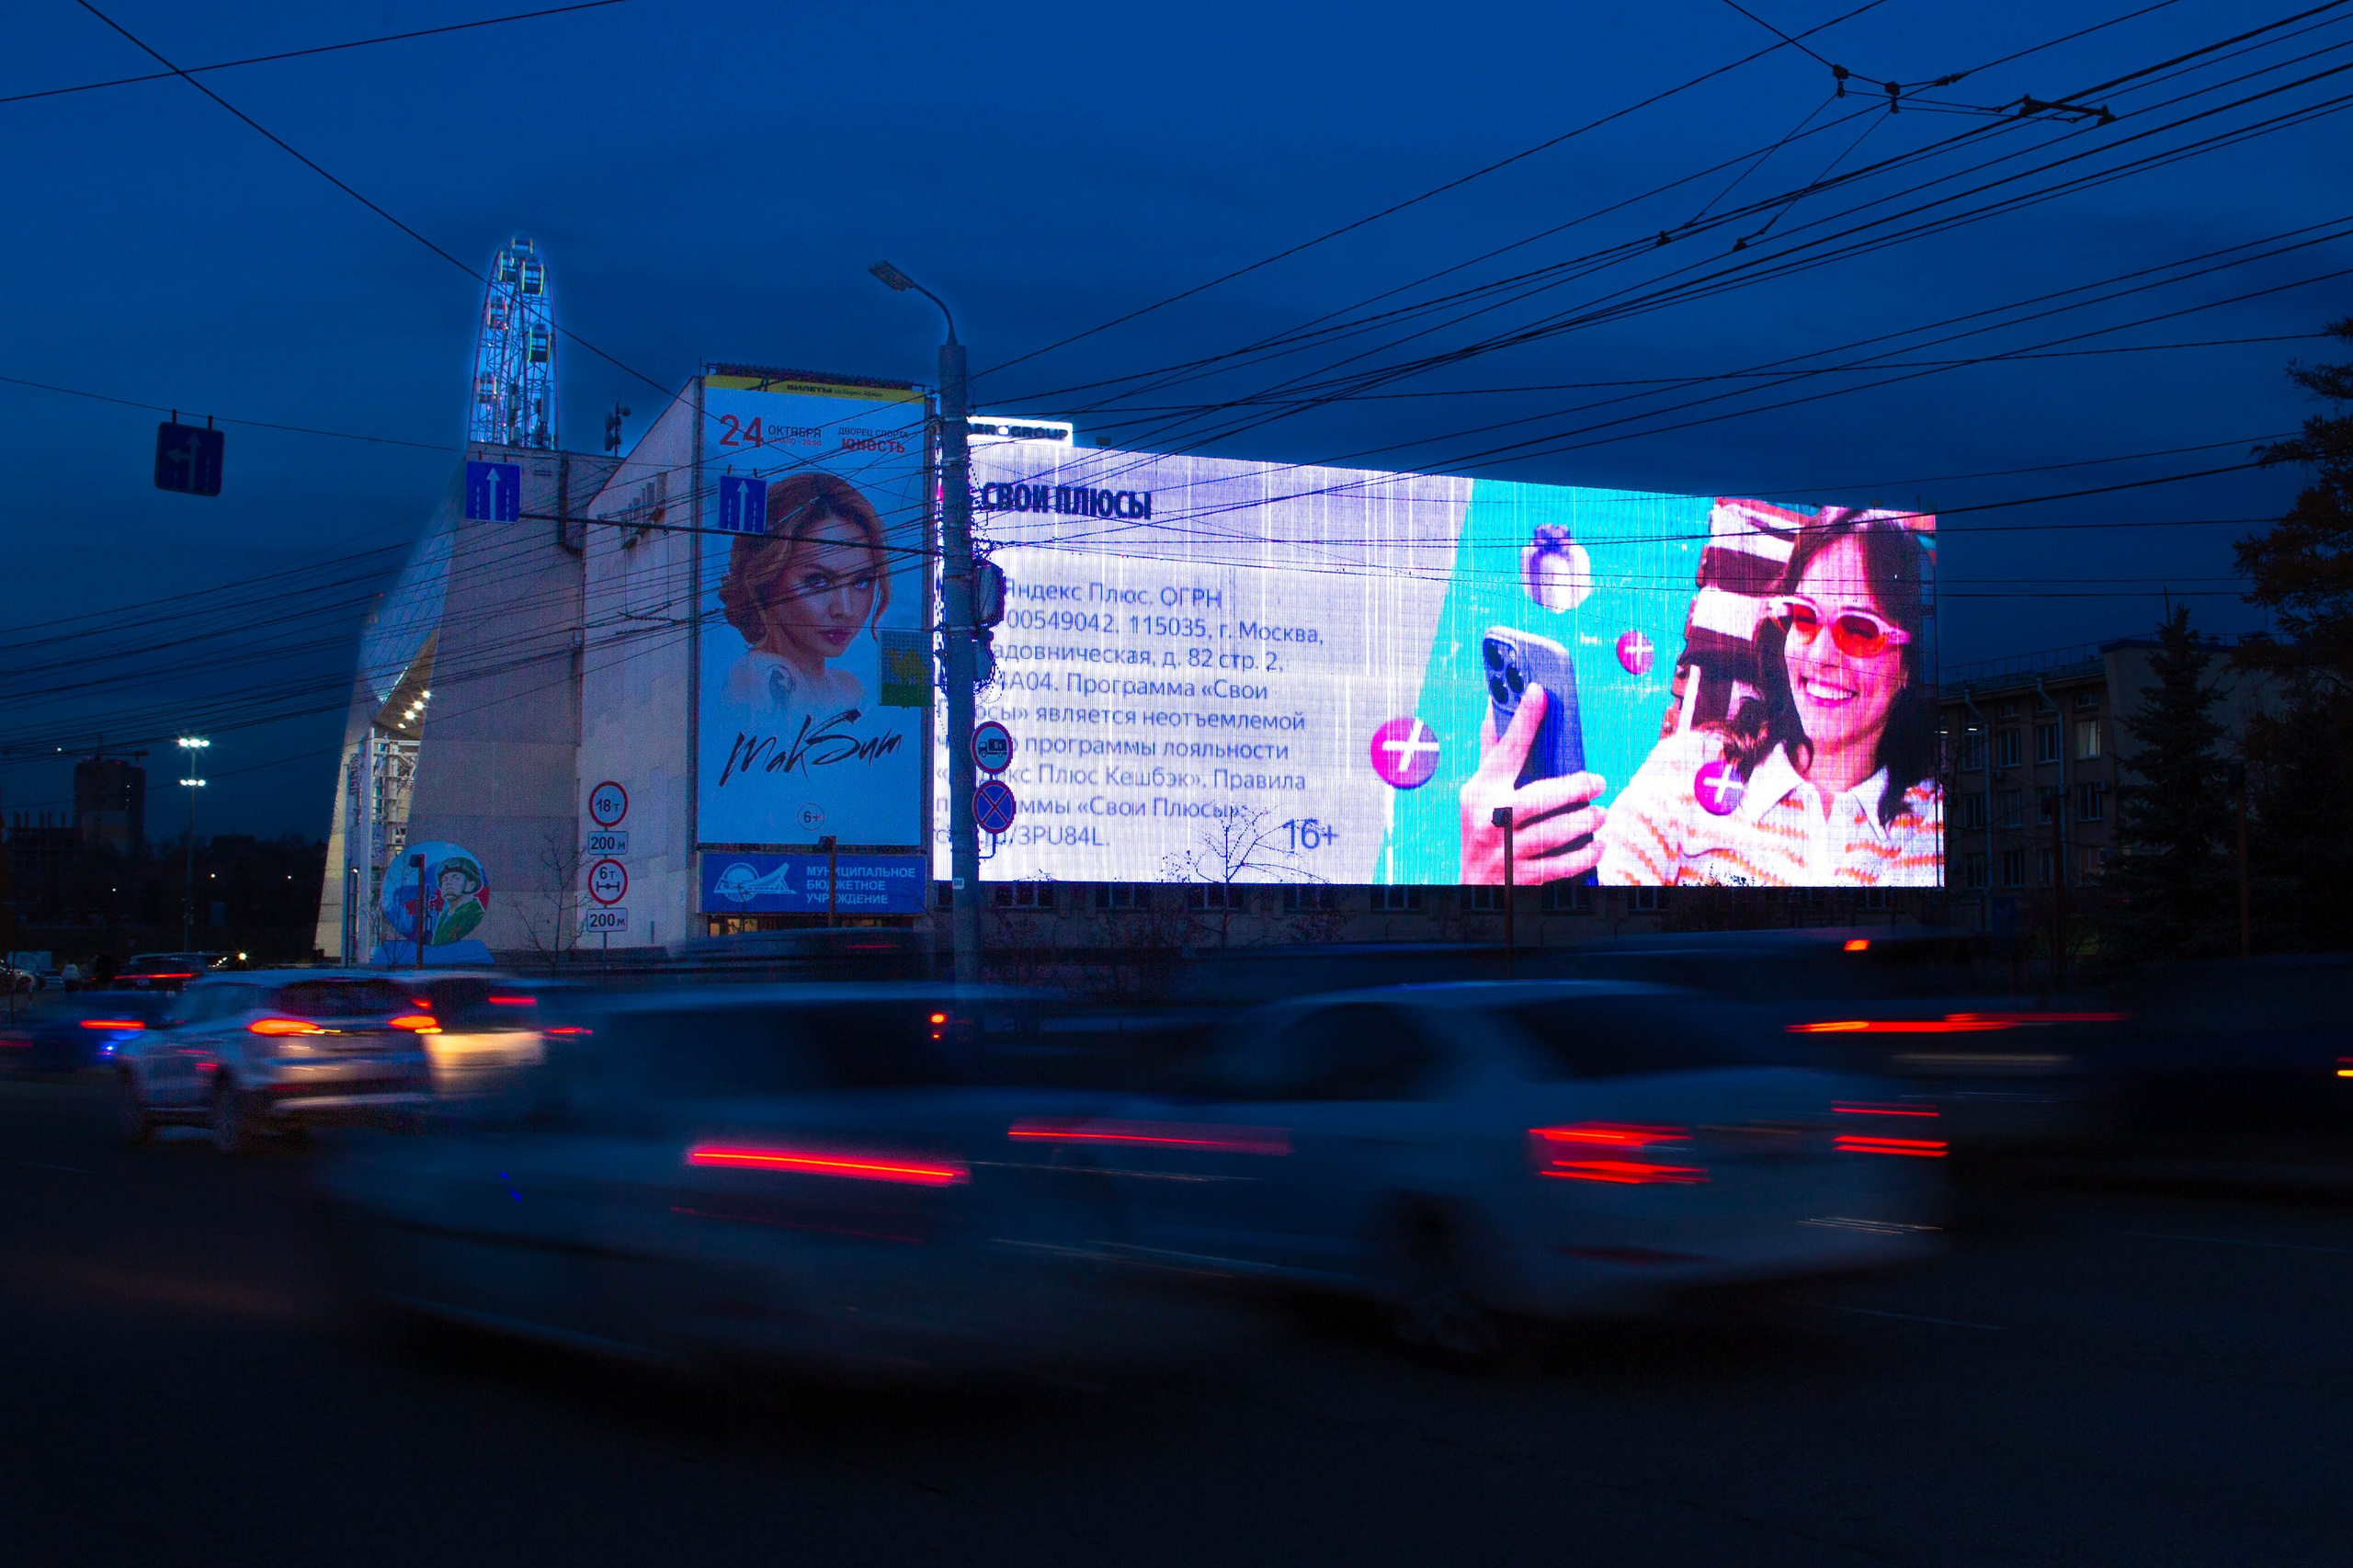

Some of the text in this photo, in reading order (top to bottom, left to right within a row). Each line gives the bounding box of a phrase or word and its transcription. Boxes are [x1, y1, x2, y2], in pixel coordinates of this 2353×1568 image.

[720, 415, 764, 448] 24
[768, 426, 821, 437] ОКТЯБРЯ
[838, 426, 909, 438] ДВОРЕЦ СПОРТА
[1011, 426, 1068, 439] GROUP
[841, 437, 905, 453] ЮНОСТЬ
[1056, 484, 1151, 520] ПЛЮСЫ
[1161, 585, 1222, 608] ОГРН
[1006, 608, 1119, 634] 00549042.
[1130, 615, 1212, 641] 115035,
[1239, 620, 1324, 645] Москва,
[993, 643, 1156, 668] адовническая,
[1188, 647, 1213, 667] 82
[1219, 652, 1259, 674] стр.
[1265, 651, 1283, 673] 2,
[1067, 672, 1195, 699] Программа
[1201, 678, 1268, 699] «Свои
[1036, 706, 1137, 726] является
[1142, 710, 1305, 731] неотъемлемой
[1026, 737, 1156, 759] программы
[1164, 741, 1289, 760] лояльности
[1039, 763, 1098, 786] Плюс
[1214, 767, 1306, 791] Правила
[802, 811, 822, 824] 6+
[1077, 795, 1146, 817] «Свои
[1281, 817, 1339, 852] 16+
